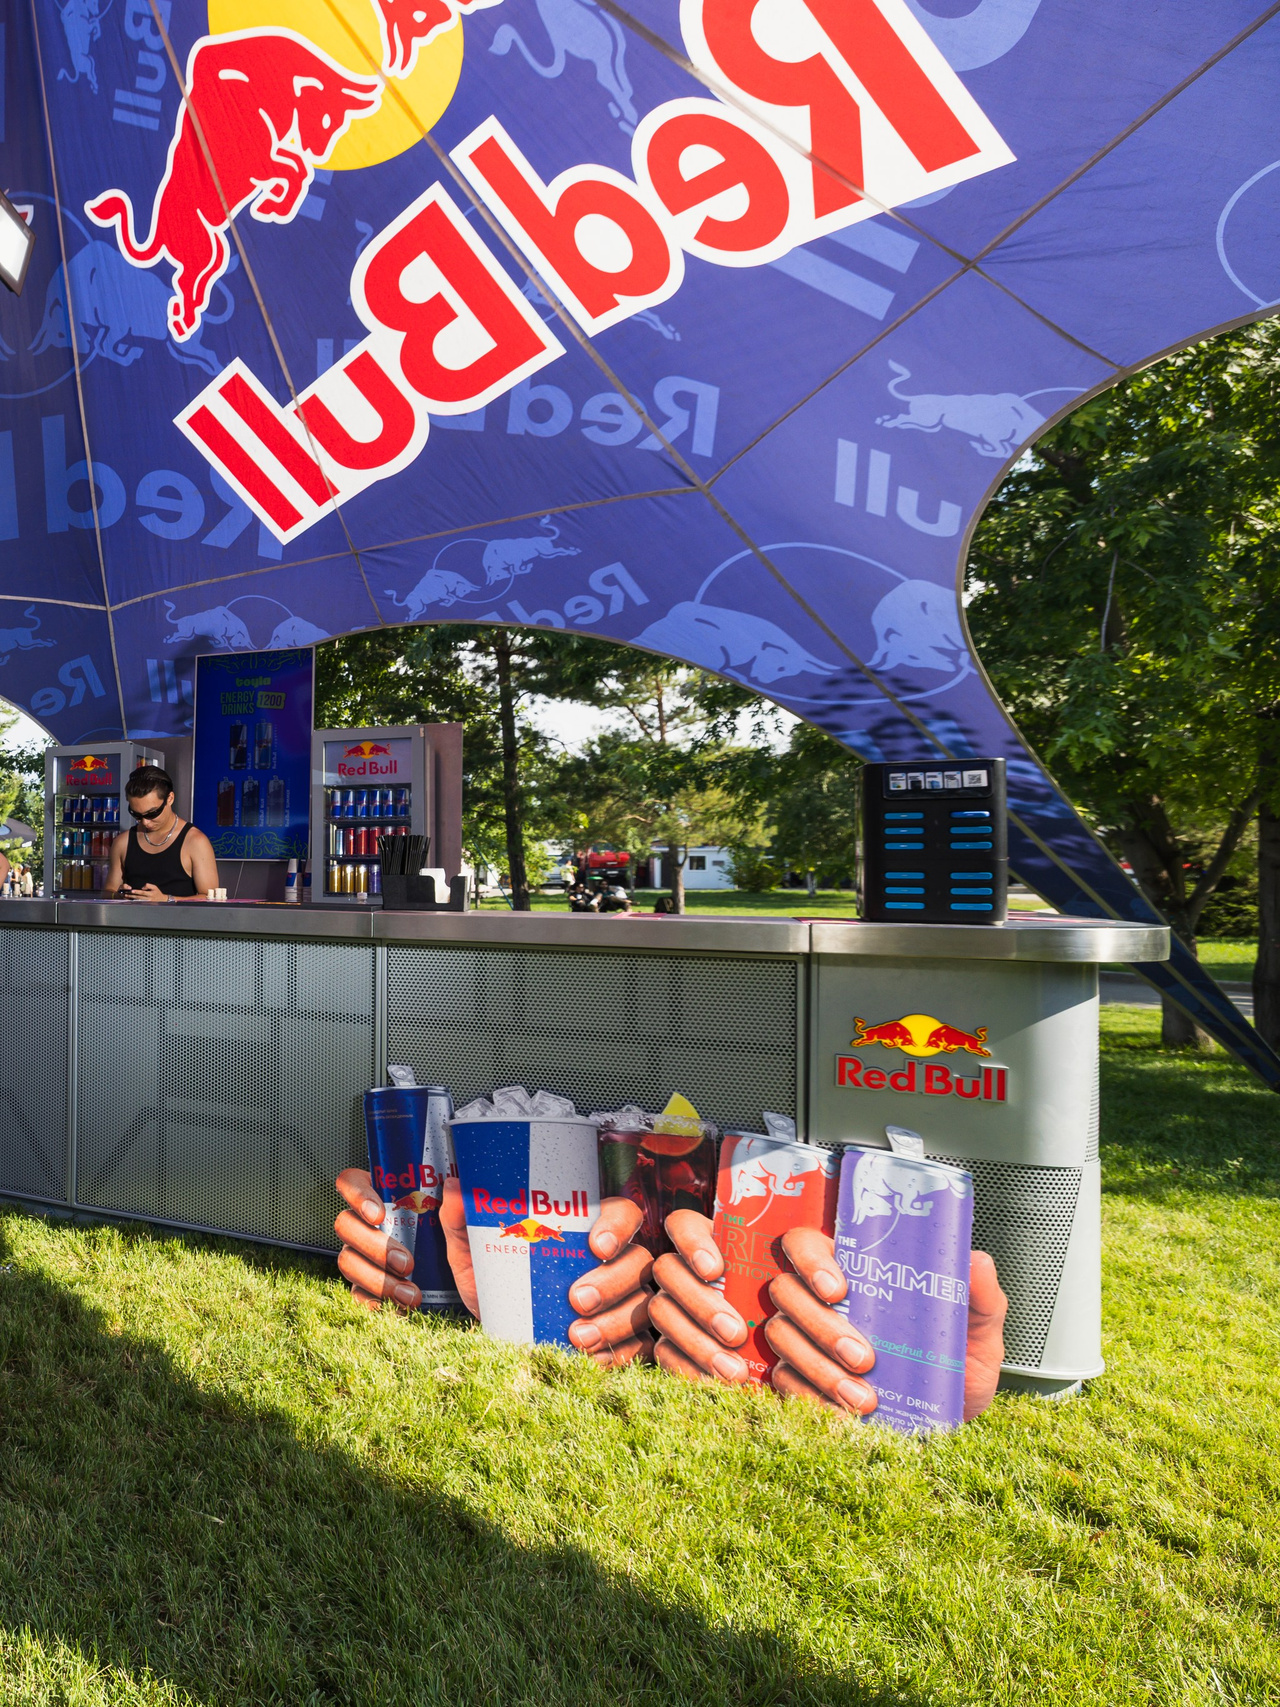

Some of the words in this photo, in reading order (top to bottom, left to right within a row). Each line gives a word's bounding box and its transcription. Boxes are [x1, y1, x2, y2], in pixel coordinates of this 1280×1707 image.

[220, 690, 255, 704] ENERGY
[259, 694, 283, 707] 1200
[222, 702, 255, 715] DRINKS
[338, 761, 366, 776] Red
[369, 760, 397, 774] Bull
[65, 774, 88, 786] Red
[90, 772, 112, 785] Bull
[838, 1056, 916, 1092] Red
[924, 1064, 1006, 1101] Bull
[373, 1163, 416, 1189] Red
[472, 1187, 528, 1215] Red
[531, 1190, 589, 1217] Bull
[382, 1217, 423, 1227] NERGY
[723, 1213, 745, 1226] THE
[837, 1235, 857, 1248] THE
[485, 1243, 536, 1255] ENERGY
[542, 1247, 587, 1259] DRINK
[724, 1260, 779, 1282] DITION
[836, 1248, 967, 1306] SUMMER
[869, 1334, 923, 1358] Grapefruit
[743, 1358, 772, 1374] ERGY
[872, 1385, 903, 1403] ERGY
[907, 1396, 941, 1414] DRINK
